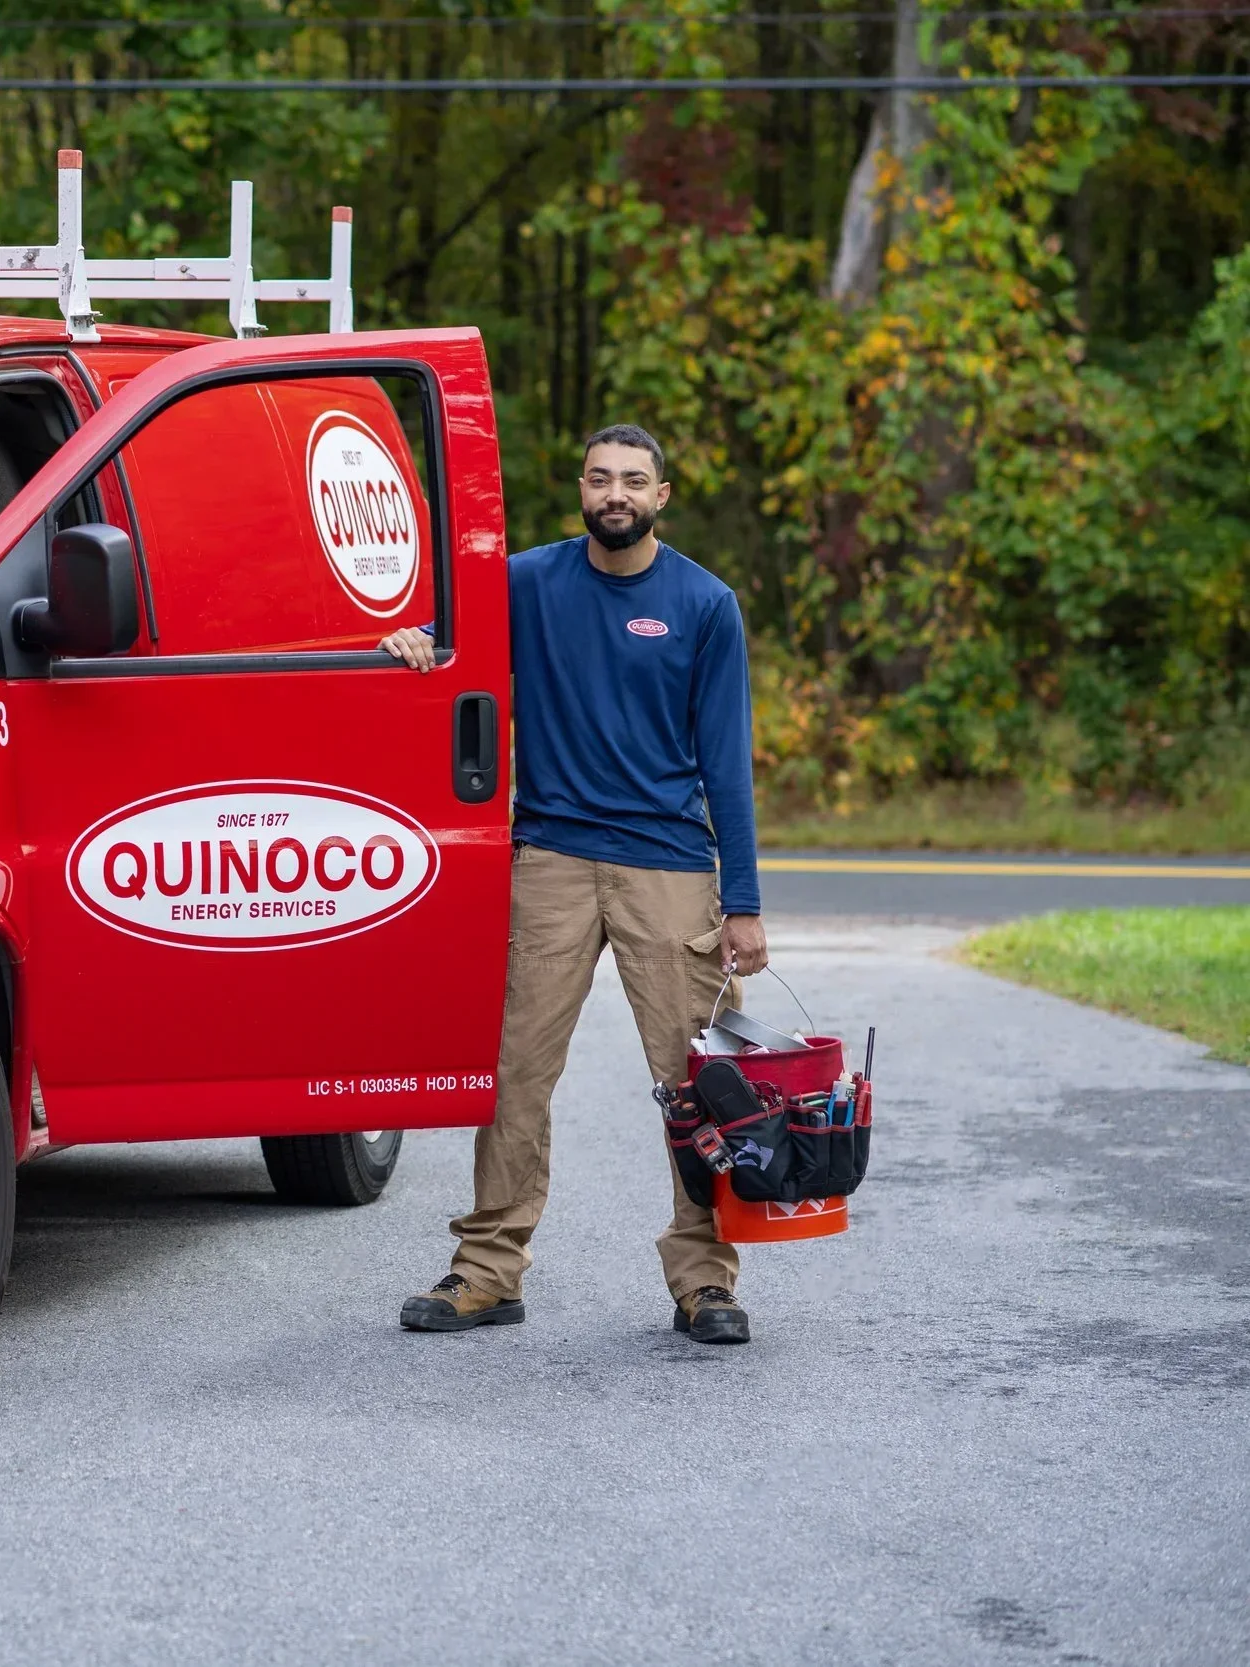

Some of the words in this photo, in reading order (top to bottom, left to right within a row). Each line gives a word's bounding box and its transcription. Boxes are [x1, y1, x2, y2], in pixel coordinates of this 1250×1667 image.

[320, 479, 409, 550] QUINOCO
[354, 556, 375, 576] ENERGY
[375, 555, 401, 575] SERVICES
[632, 622, 663, 632] QUINOCO
[217, 813, 256, 828] SINCE
[259, 812, 290, 827] 1877
[103, 834, 405, 901] QUINOCO
[171, 903, 243, 920] ENERGY
[249, 900, 337, 918] SERVICES
[307, 1080, 330, 1095] LIC
[334, 1079, 355, 1095] S-1
[360, 1077, 418, 1094] 0303545
[426, 1076, 457, 1091] HOD
[461, 1075, 493, 1090] 1243
